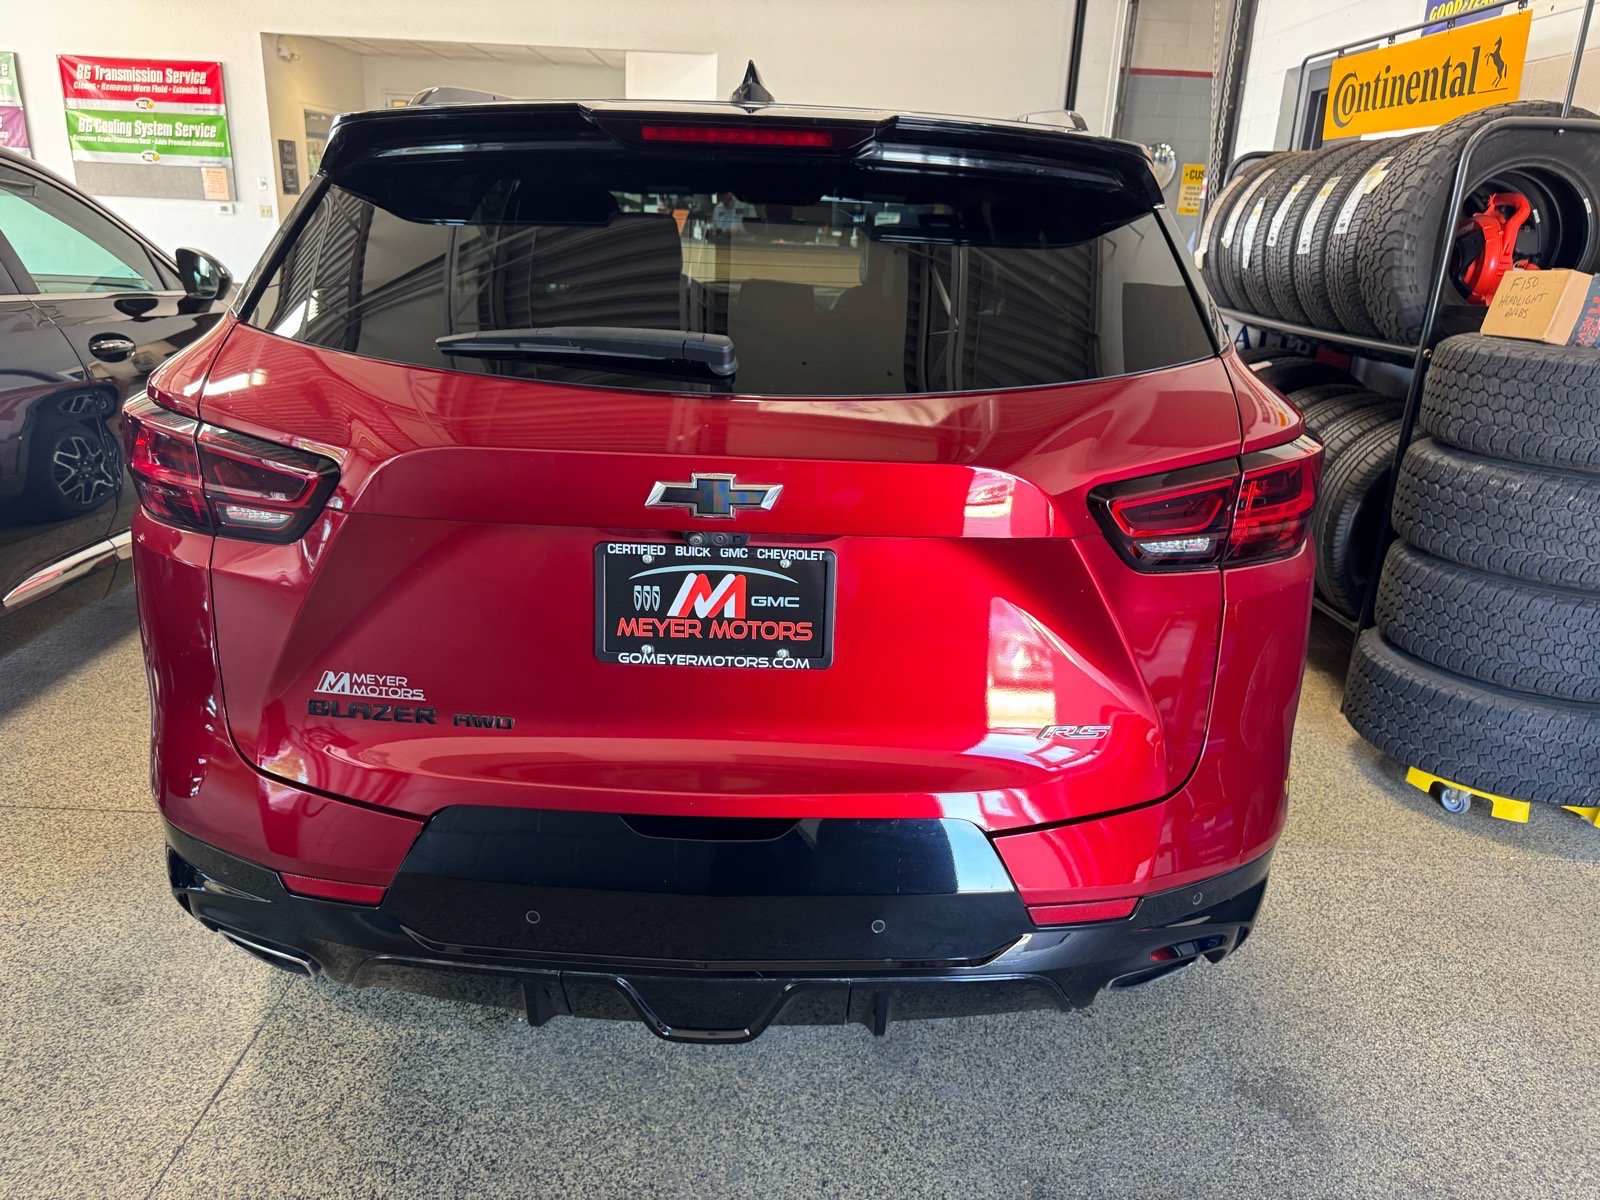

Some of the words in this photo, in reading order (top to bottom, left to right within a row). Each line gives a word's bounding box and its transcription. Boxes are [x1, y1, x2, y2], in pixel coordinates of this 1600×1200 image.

[1429, 0, 1499, 21] GOODYE
[75, 64, 92, 81] BG
[95, 64, 164, 84] Transmission
[165, 67, 207, 85] Service
[100, 82, 133, 92] Removes
[132, 84, 151, 93] Worn
[151, 84, 168, 94] Fluid
[172, 85, 198, 95] Extends
[1333, 45, 1481, 129] Continental
[77, 117, 93, 134] BG
[95, 119, 132, 137] Cooling
[134, 119, 173, 138] System
[174, 122, 217, 139] Service
[1498, 292, 1549, 308] HEADLIGHT
[1504, 307, 1530, 319] BULBS
[607, 543, 666, 556] CERTIFIED
[675, 546, 712, 558] BUICK
[720, 547, 749, 559] GMC
[756, 549, 825, 561] CHEVROLET
[751, 596, 800, 608] GMC
[616, 617, 703, 639] MEYER
[708, 620, 813, 641] MOTORS
[617, 652, 811, 670] GOMEYERMOTORS.COM
[351, 672, 408, 687] MEYER
[350, 686, 426, 700] MOTORS
[307, 699, 437, 726] BLAZER
[453, 713, 516, 730] AWD
[1036, 725, 1112, 740] RS
